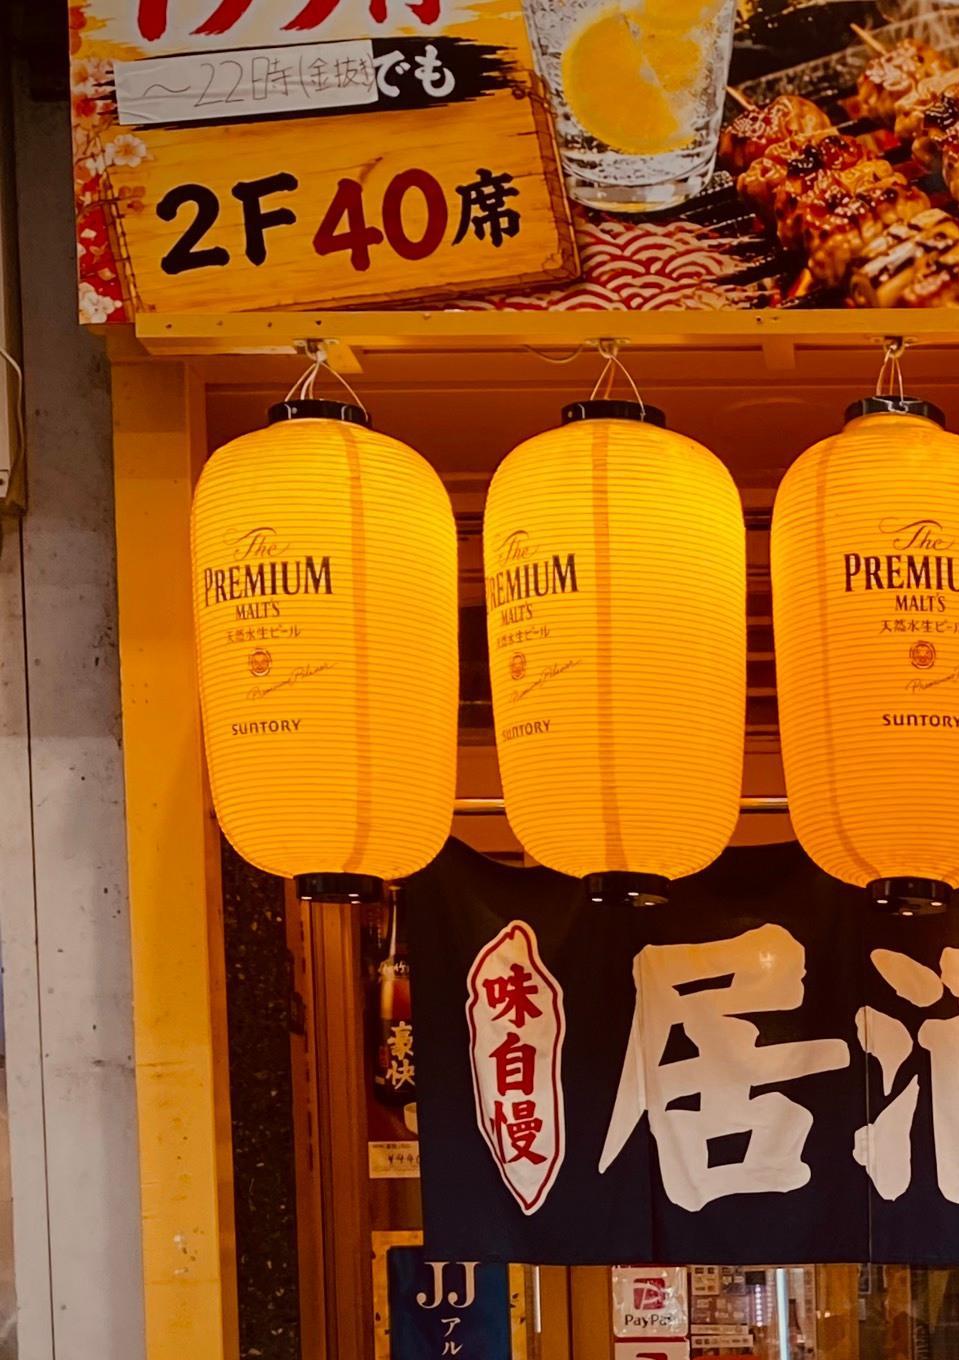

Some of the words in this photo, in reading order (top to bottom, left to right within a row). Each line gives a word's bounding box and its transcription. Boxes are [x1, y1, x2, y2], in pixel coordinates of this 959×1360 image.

[374, 45, 455, 98] でも
[157, 172, 298, 274] 2F
[313, 168, 521, 271] 40席
[204, 556, 333, 608] PREMIUM
[235, 600, 280, 620] MALT'S
[501, 602, 533, 626] MALT'S
[895, 593, 946, 613] MALT'S
[231, 719, 301, 736] SUNTORY
[501, 718, 551, 742] SUNTORY
[482, 964, 548, 1167] 味自慢
[416, 1262, 481, 1309] JJ
